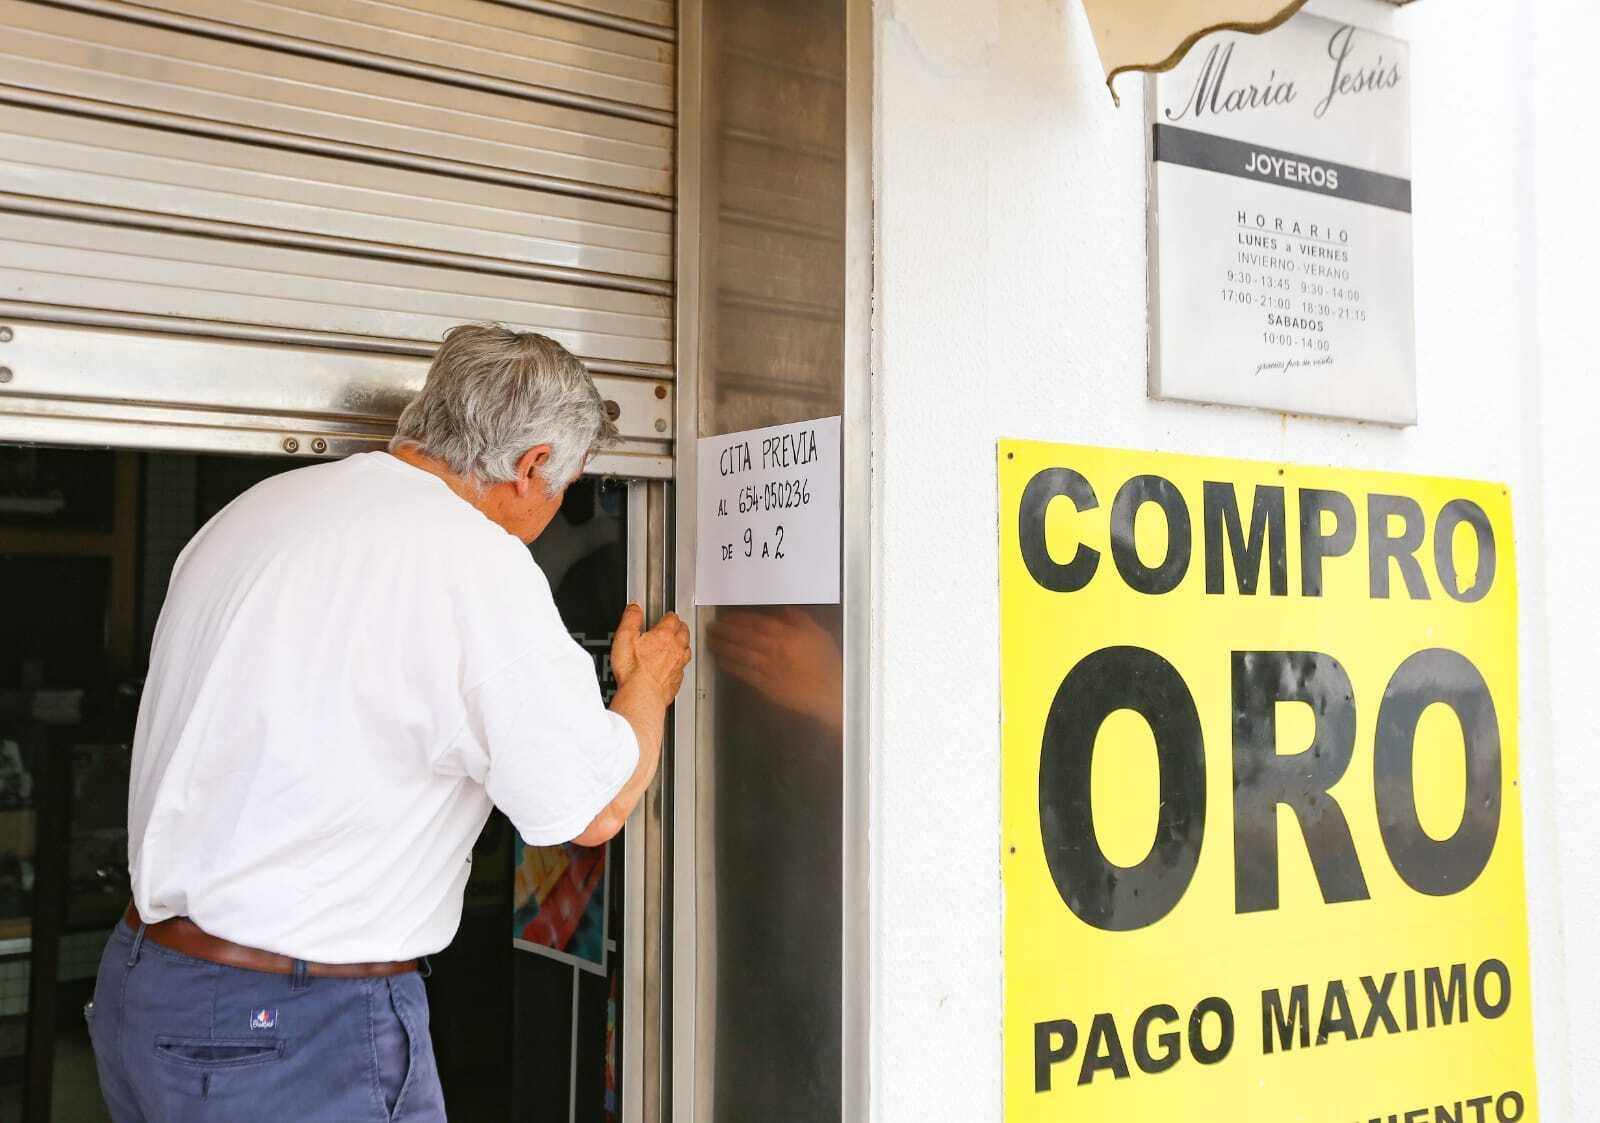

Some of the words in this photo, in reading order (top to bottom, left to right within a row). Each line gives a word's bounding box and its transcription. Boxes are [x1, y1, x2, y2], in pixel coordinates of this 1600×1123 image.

[1245, 152, 1339, 190] JOYEROS
[1237, 211, 1349, 242] HORARIO
[1238, 233, 1278, 250] LUNES
[1286, 244, 1292, 253] a
[1299, 245, 1349, 263] VIERNES
[1267, 313, 1324, 333] SABADOS
[720, 442, 752, 476] CITA
[762, 430, 818, 470] PREVIA
[718, 499, 728, 517] AL
[722, 544, 733, 560] DE
[743, 528, 753, 557] 9
[761, 542, 769, 558] A
[775, 526, 785, 559] 2
[1018, 466, 1496, 604] COMPRO
[1039, 645, 1502, 932] ORO
[1034, 997, 1234, 1093] PAGO
[1261, 958, 1511, 1055] MAXIMO
